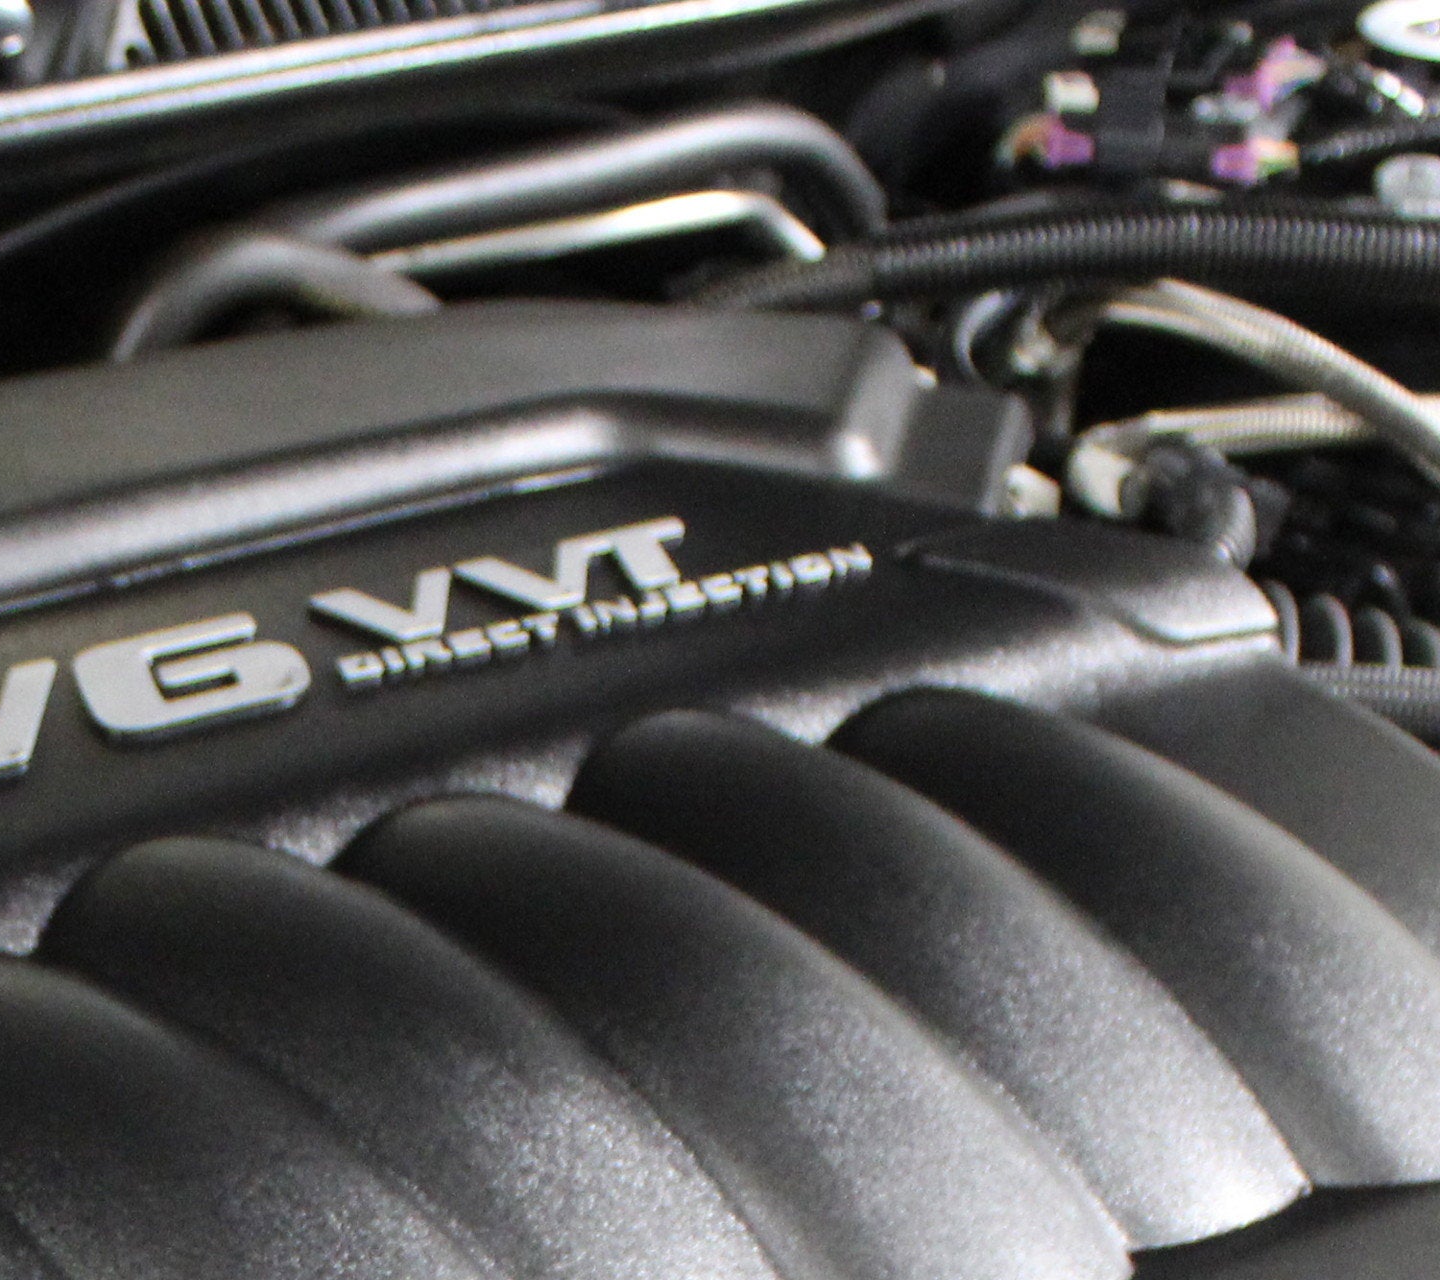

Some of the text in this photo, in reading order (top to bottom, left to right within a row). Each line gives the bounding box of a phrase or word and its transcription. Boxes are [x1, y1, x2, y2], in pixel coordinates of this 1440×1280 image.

[307, 515, 686, 643] VVT
[335, 543, 875, 687] DIRECT INJECTION
